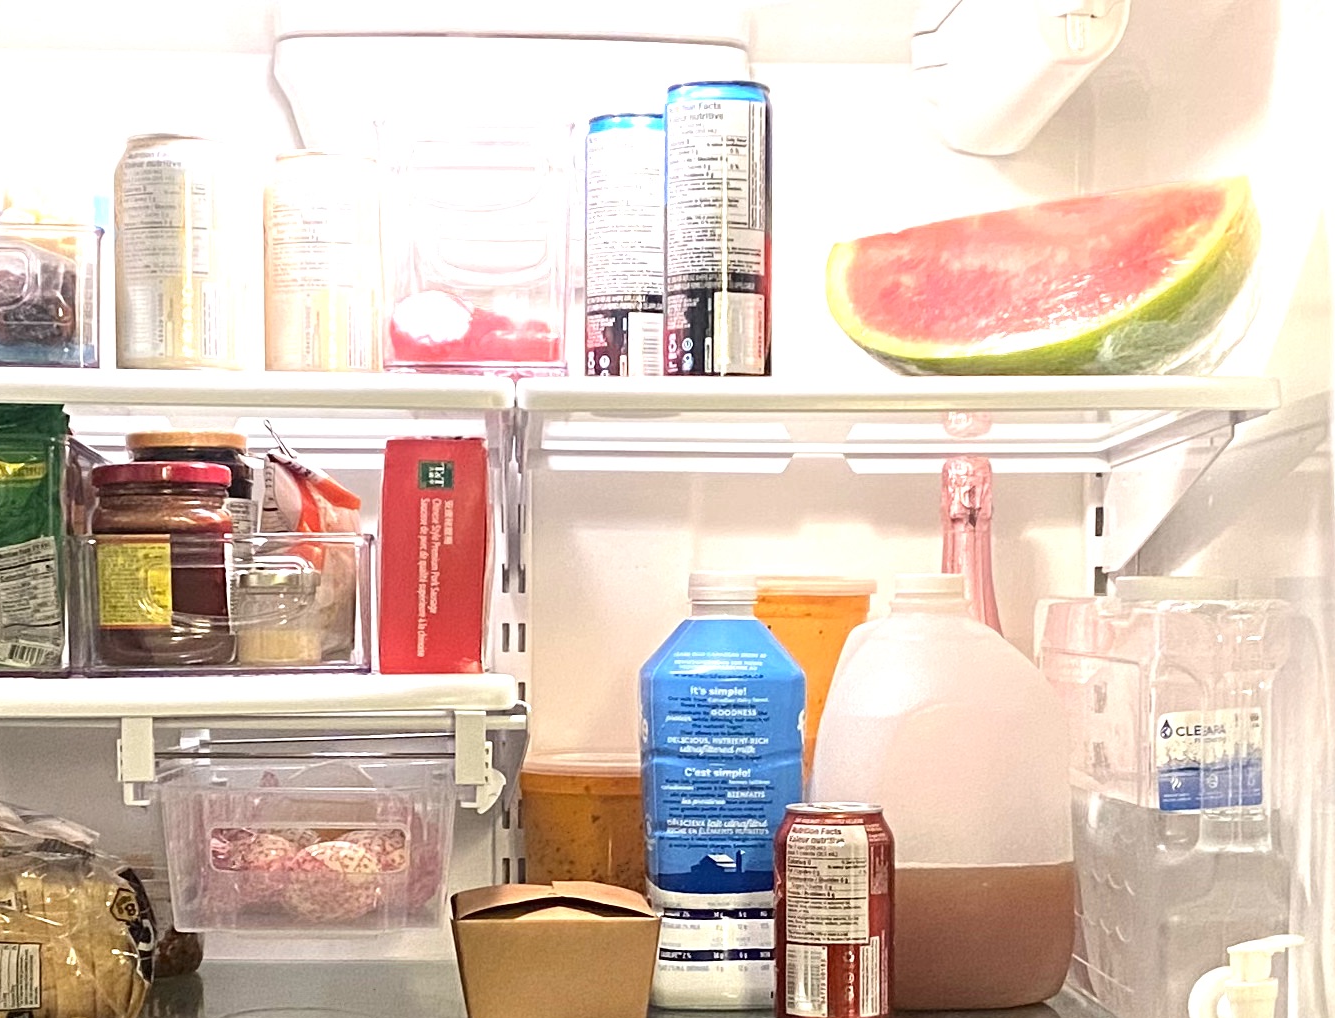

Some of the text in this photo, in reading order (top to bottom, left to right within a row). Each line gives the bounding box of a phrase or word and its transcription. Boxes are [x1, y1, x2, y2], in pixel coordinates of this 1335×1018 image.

[435, 463, 444, 487] T&T
[430, 524, 440, 540] Style
[431, 572, 439, 586] Pork
[429, 587, 438, 613] Sausage
[709, 687, 747, 697] simple!
[684, 768, 751, 779] C'est simple!
